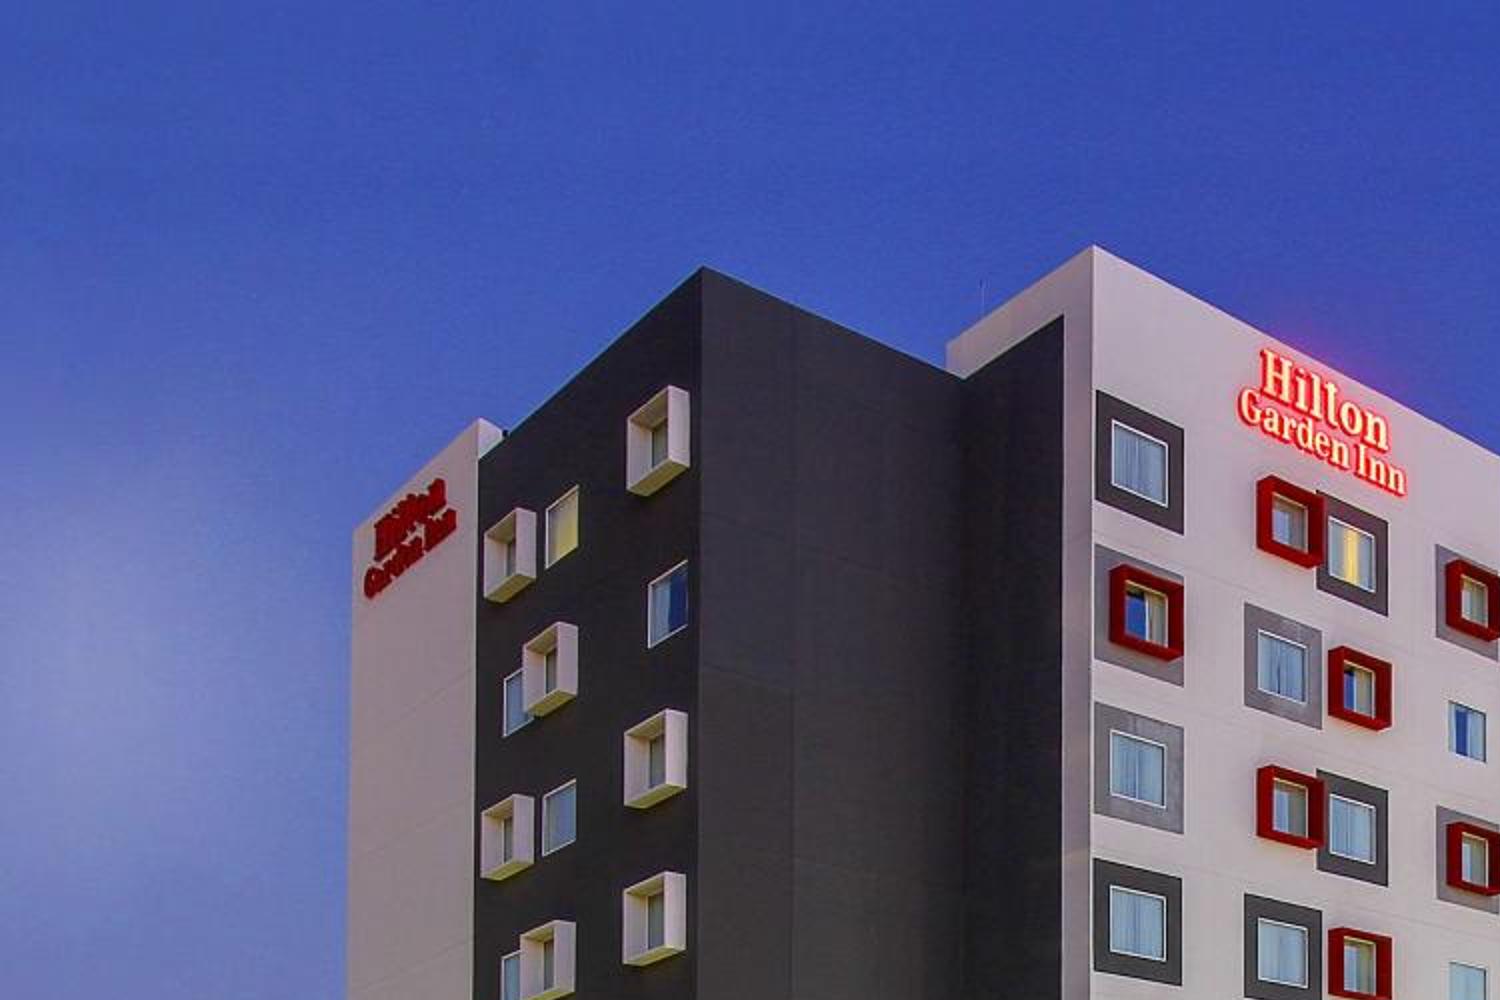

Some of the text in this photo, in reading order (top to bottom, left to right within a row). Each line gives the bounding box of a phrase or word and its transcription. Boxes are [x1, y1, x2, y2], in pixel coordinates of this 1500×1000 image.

[1238, 388, 1407, 497] Garden Inn
[1261, 348, 1389, 452] Hilton
